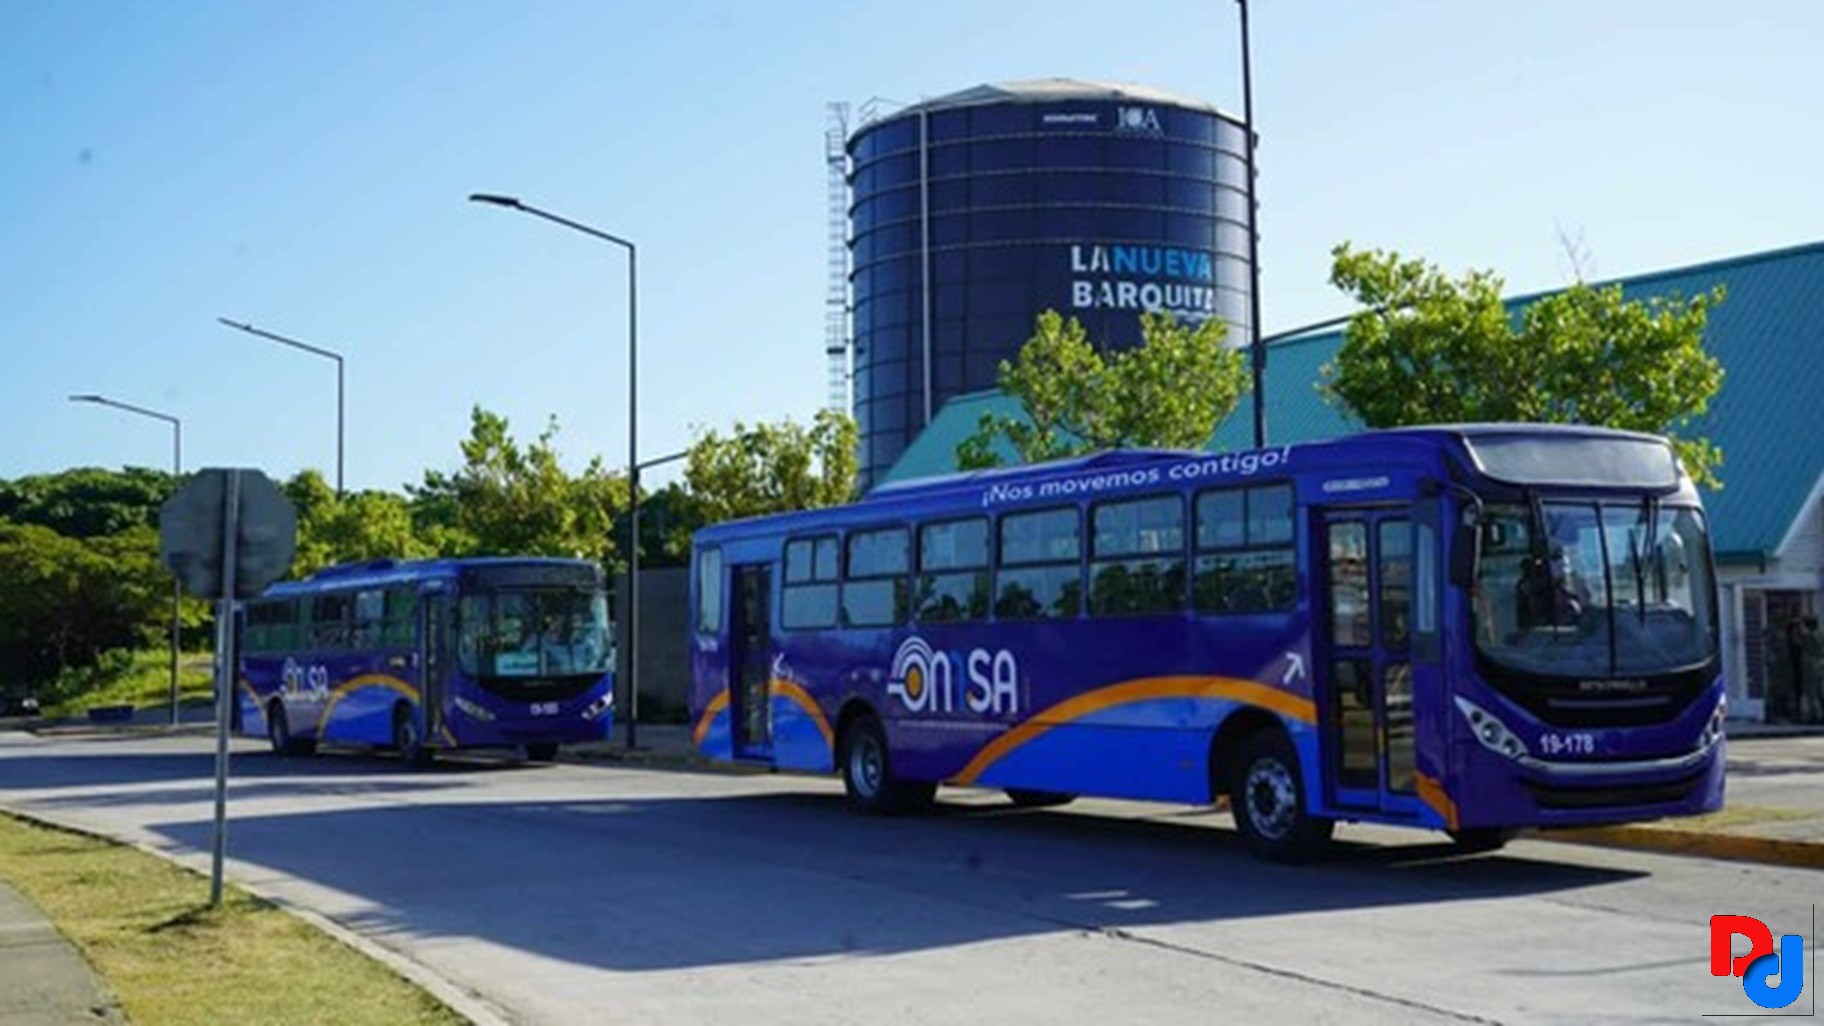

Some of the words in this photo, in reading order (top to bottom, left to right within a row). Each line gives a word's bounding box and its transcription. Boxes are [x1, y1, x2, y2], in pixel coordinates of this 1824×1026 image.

[1039, 466, 1160, 498] movemos
[1168, 445, 1291, 475] contigo!
[1540, 733, 1594, 754] 19-178
